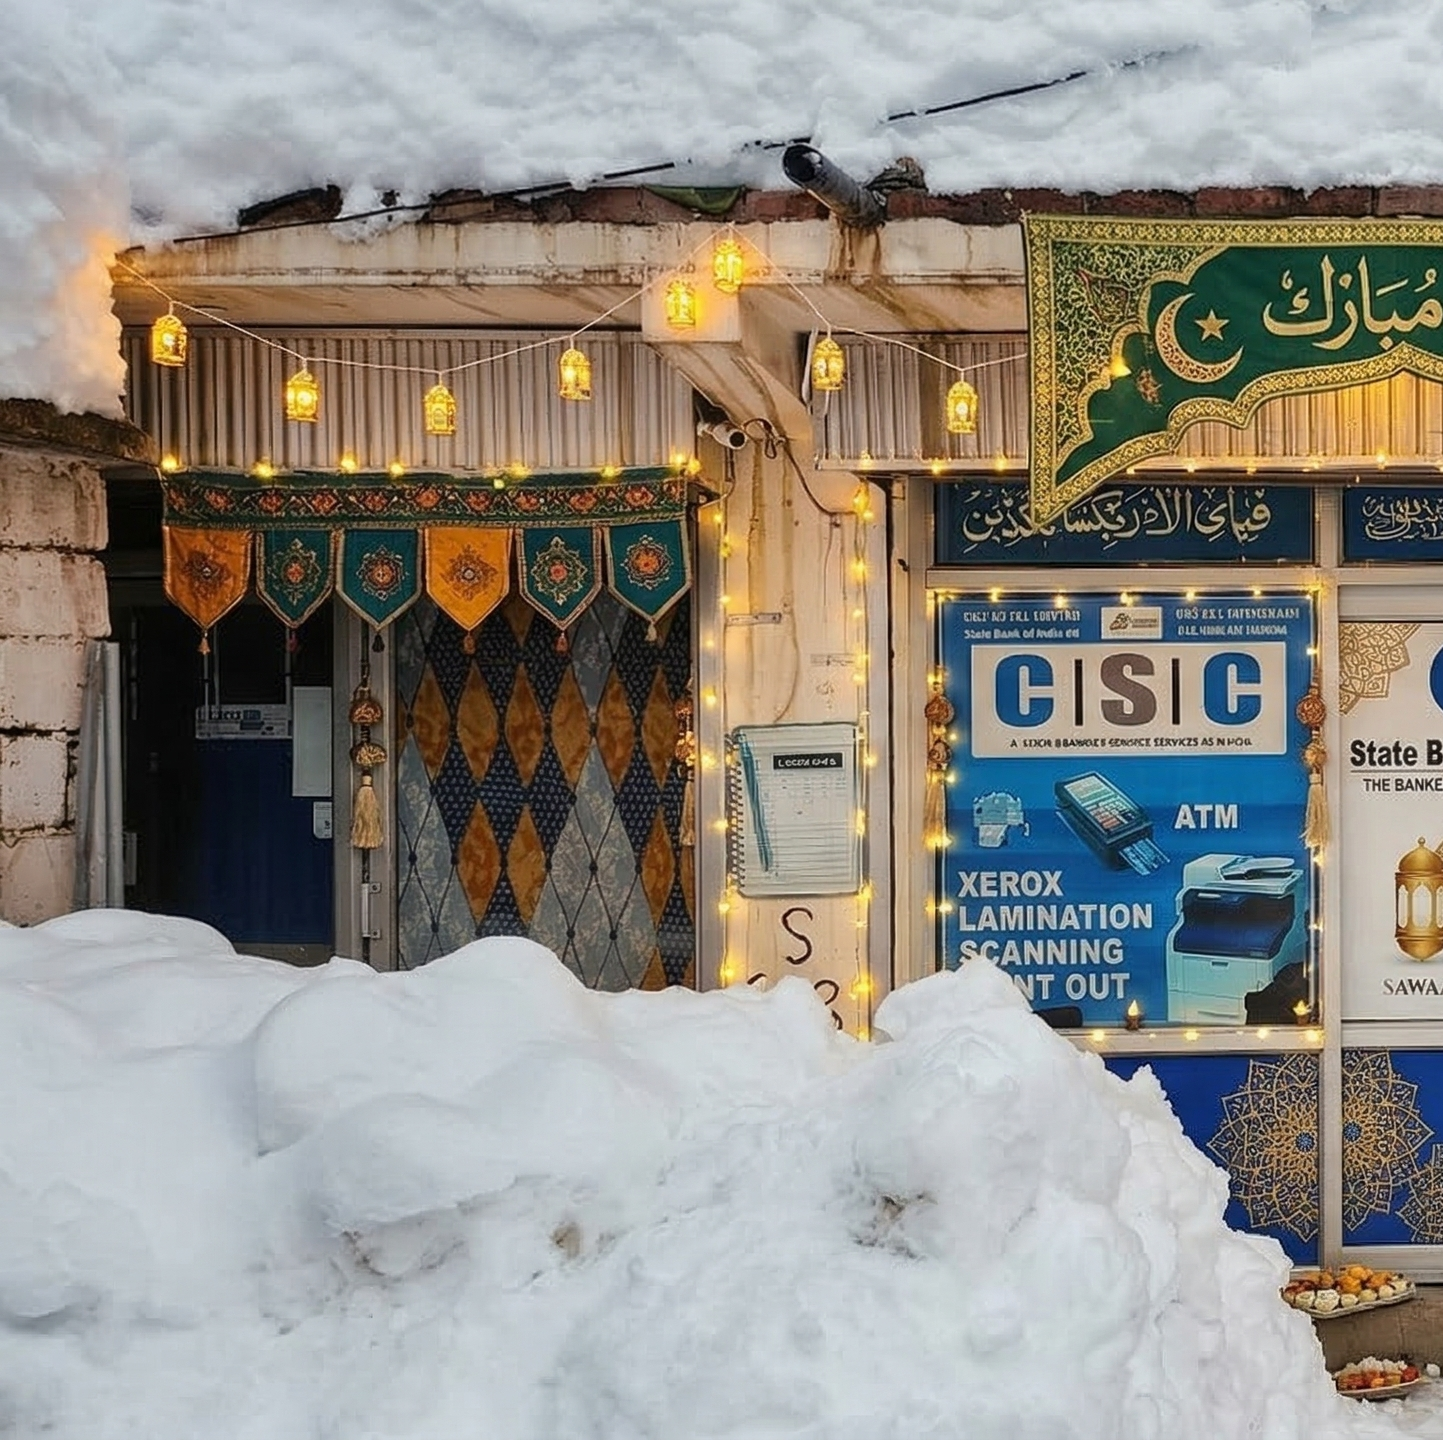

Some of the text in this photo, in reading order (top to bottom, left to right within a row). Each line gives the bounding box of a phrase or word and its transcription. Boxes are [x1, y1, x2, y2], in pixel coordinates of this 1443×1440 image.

[1350, 739, 1418, 767] State
[1363, 778, 1390, 792] THE
[1174, 804, 1238, 829] ATM
[958, 870, 1064, 898] XEROX
[959, 903, 1153, 931] LAMINATION
[781, 907, 813, 965] S
[959, 938, 1124, 966] SCANNING
[1065, 973, 1130, 1001] OUT
